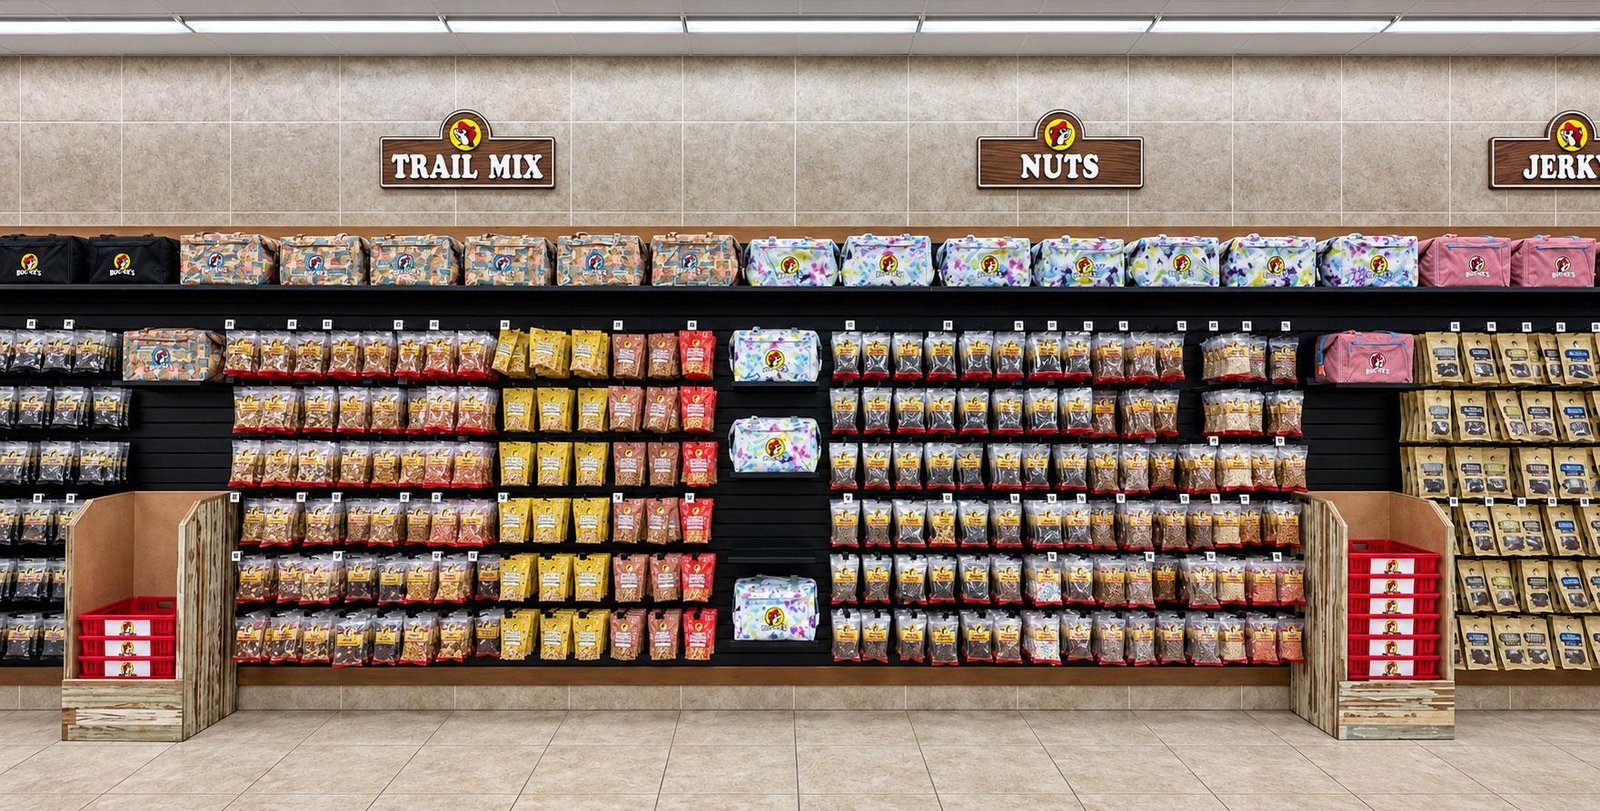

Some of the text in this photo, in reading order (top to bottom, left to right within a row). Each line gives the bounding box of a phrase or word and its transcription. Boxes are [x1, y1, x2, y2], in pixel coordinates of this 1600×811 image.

[391, 153, 544, 179] TRAIL MIX
[1020, 153, 1099, 179] NUTS
[1523, 154, 1600, 179] JERK
